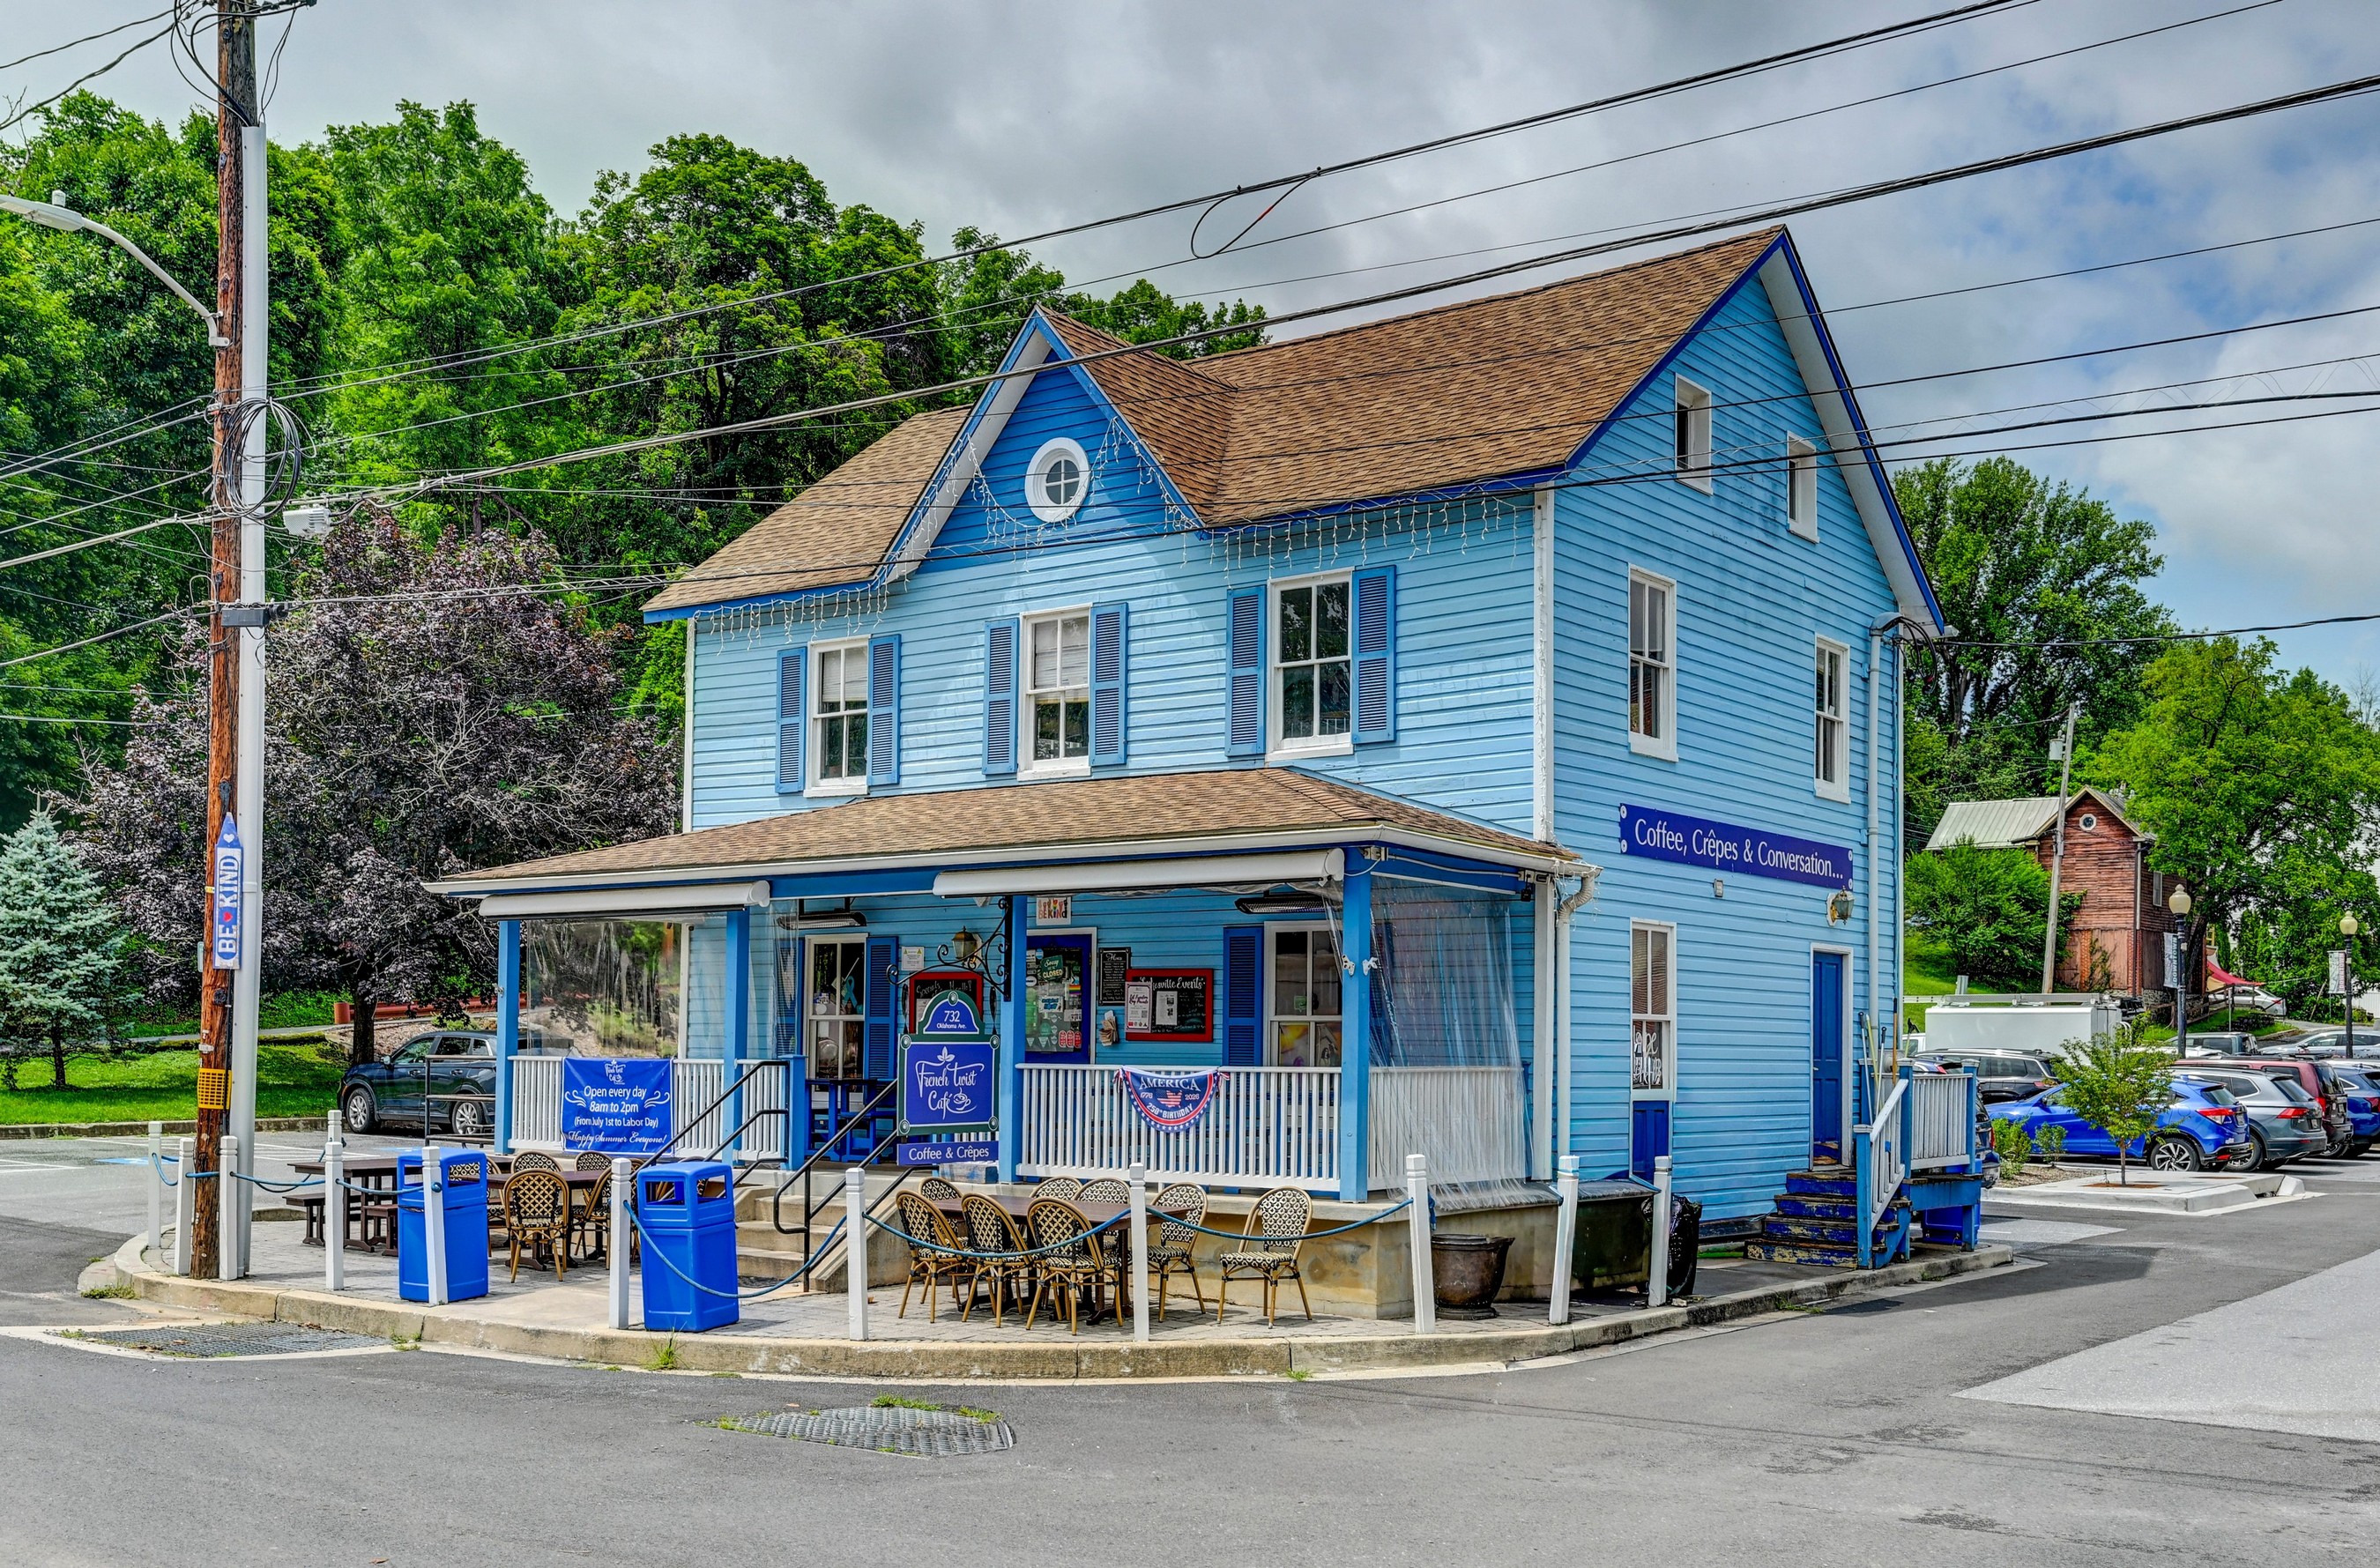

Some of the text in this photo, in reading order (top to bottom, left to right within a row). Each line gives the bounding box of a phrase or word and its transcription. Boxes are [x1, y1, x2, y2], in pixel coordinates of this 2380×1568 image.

[1634, 818, 1843, 879] Coffee, Crêpes & Conversation...
[218, 858, 240, 954] BE KIND
[1045, 959, 1059, 968] Sorry
[1043, 970, 1063, 978] CLOSED
[1176, 977, 1202, 990] Events
[944, 1010, 961, 1022] 732
[915, 1060, 985, 1098] French Twist
[1139, 1077, 1201, 1092] AMERICA
[584, 1085, 646, 1100] Open every day
[590, 1101, 638, 1115] 8am to 2pm
[928, 1090, 953, 1119] Café
[1162, 1103, 1194, 1119] BIRTHDAY
[574, 1116, 658, 1128] (From July 1st to Labor Day)
[568, 1131, 667, 1151] Happy Summer Everyone!
[909, 1145, 989, 1161] Coffee & Crêpes
